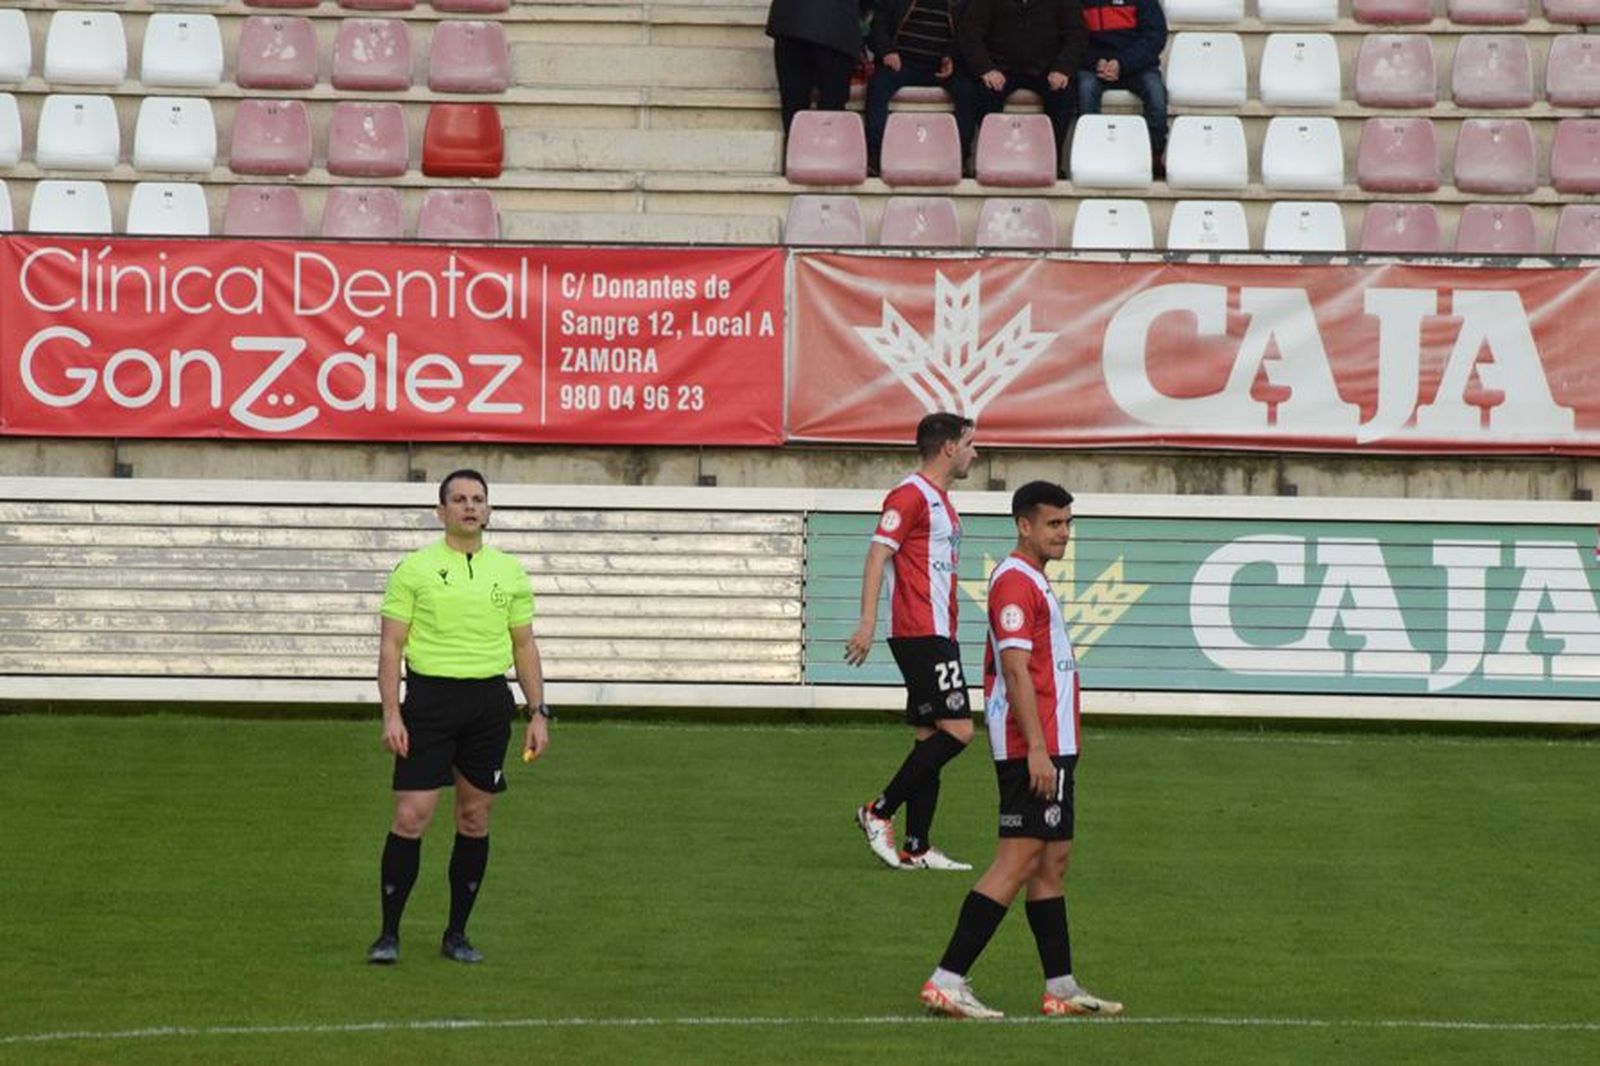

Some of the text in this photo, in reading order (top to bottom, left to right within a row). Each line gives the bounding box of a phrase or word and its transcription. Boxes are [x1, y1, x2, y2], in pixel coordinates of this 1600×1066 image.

[19, 246, 529, 320] Clínica Dental
[560, 272, 731, 301] C/ Donantes de
[560, 309, 775, 341] Sangre 12, Local A
[560, 347, 659, 373] ZAMORA
[1102, 282, 1576, 444] CAJA
[560, 384, 705, 411] 980 04 96 23
[1189, 533, 1600, 693] CAJA
[934, 660, 964, 691] 22
